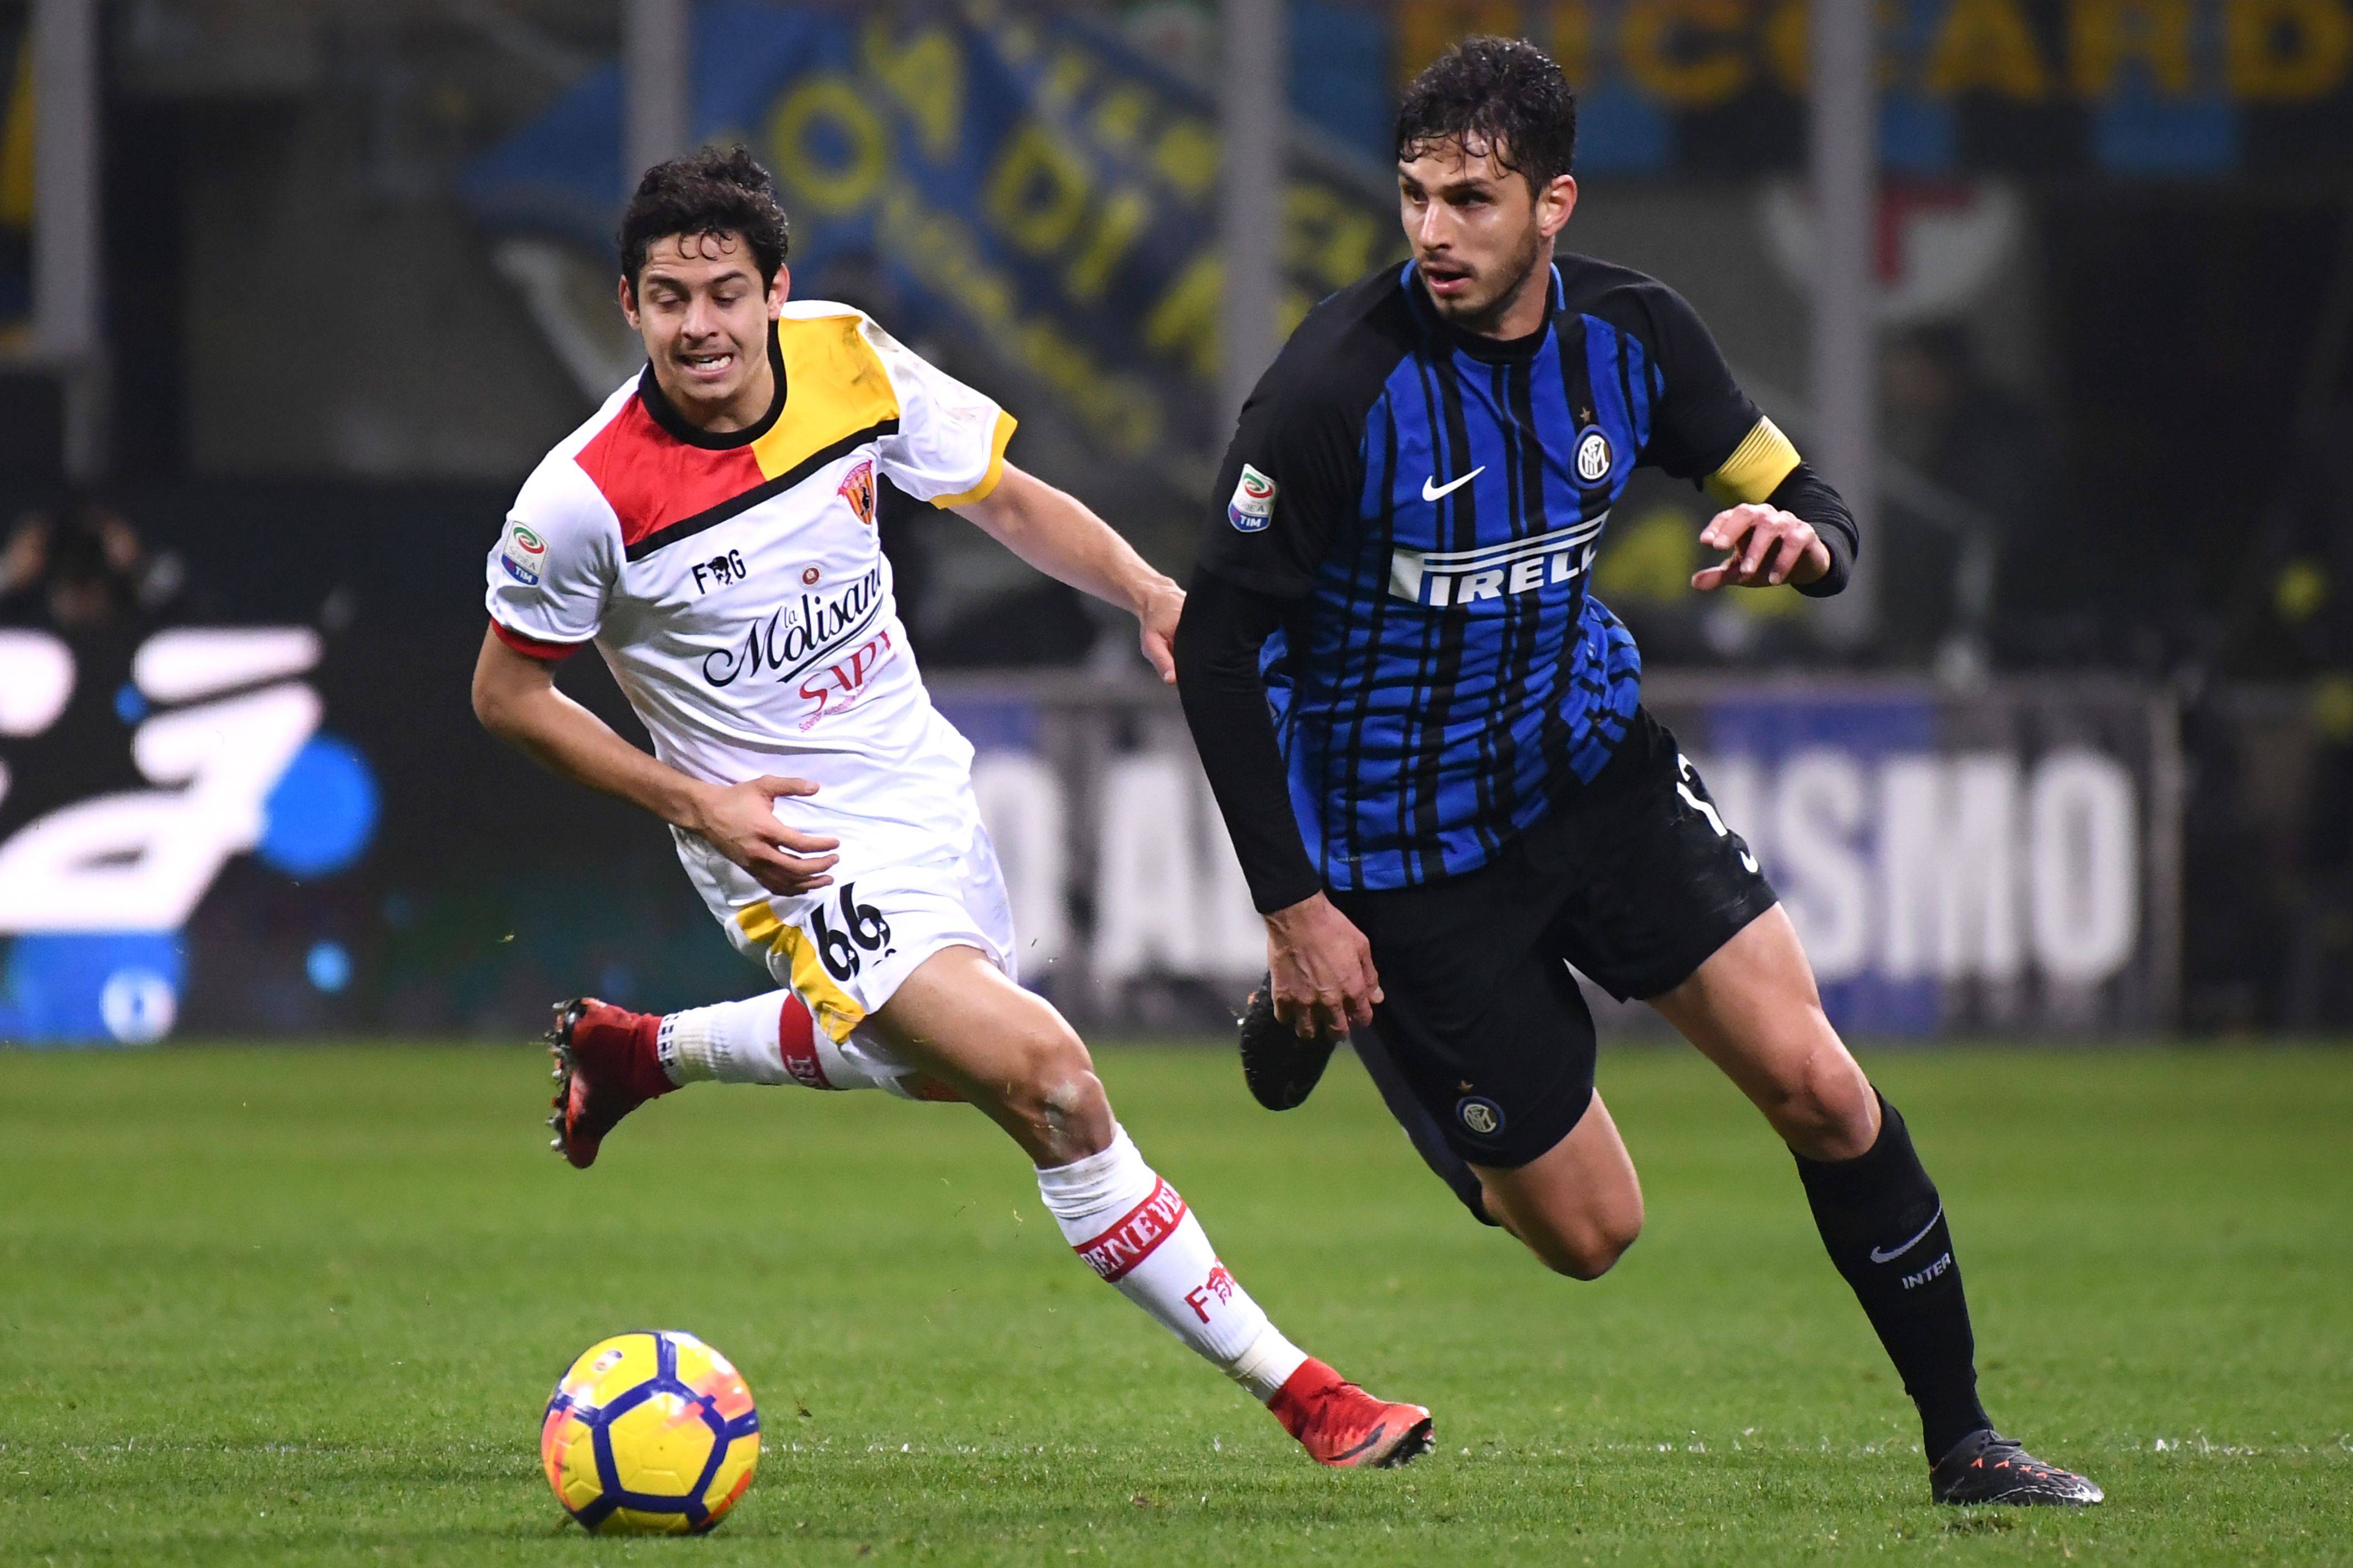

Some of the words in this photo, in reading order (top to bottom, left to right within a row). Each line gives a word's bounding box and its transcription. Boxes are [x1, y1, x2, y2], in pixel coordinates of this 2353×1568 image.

[1240, 514, 1262, 527] TIM
[515, 565, 533, 583] TIM
[784, 607, 798, 629] la
[810, 881, 891, 982] 66
[1080, 1180, 1182, 1277] BENEVE
[1901, 1253, 1951, 1290] INTER
